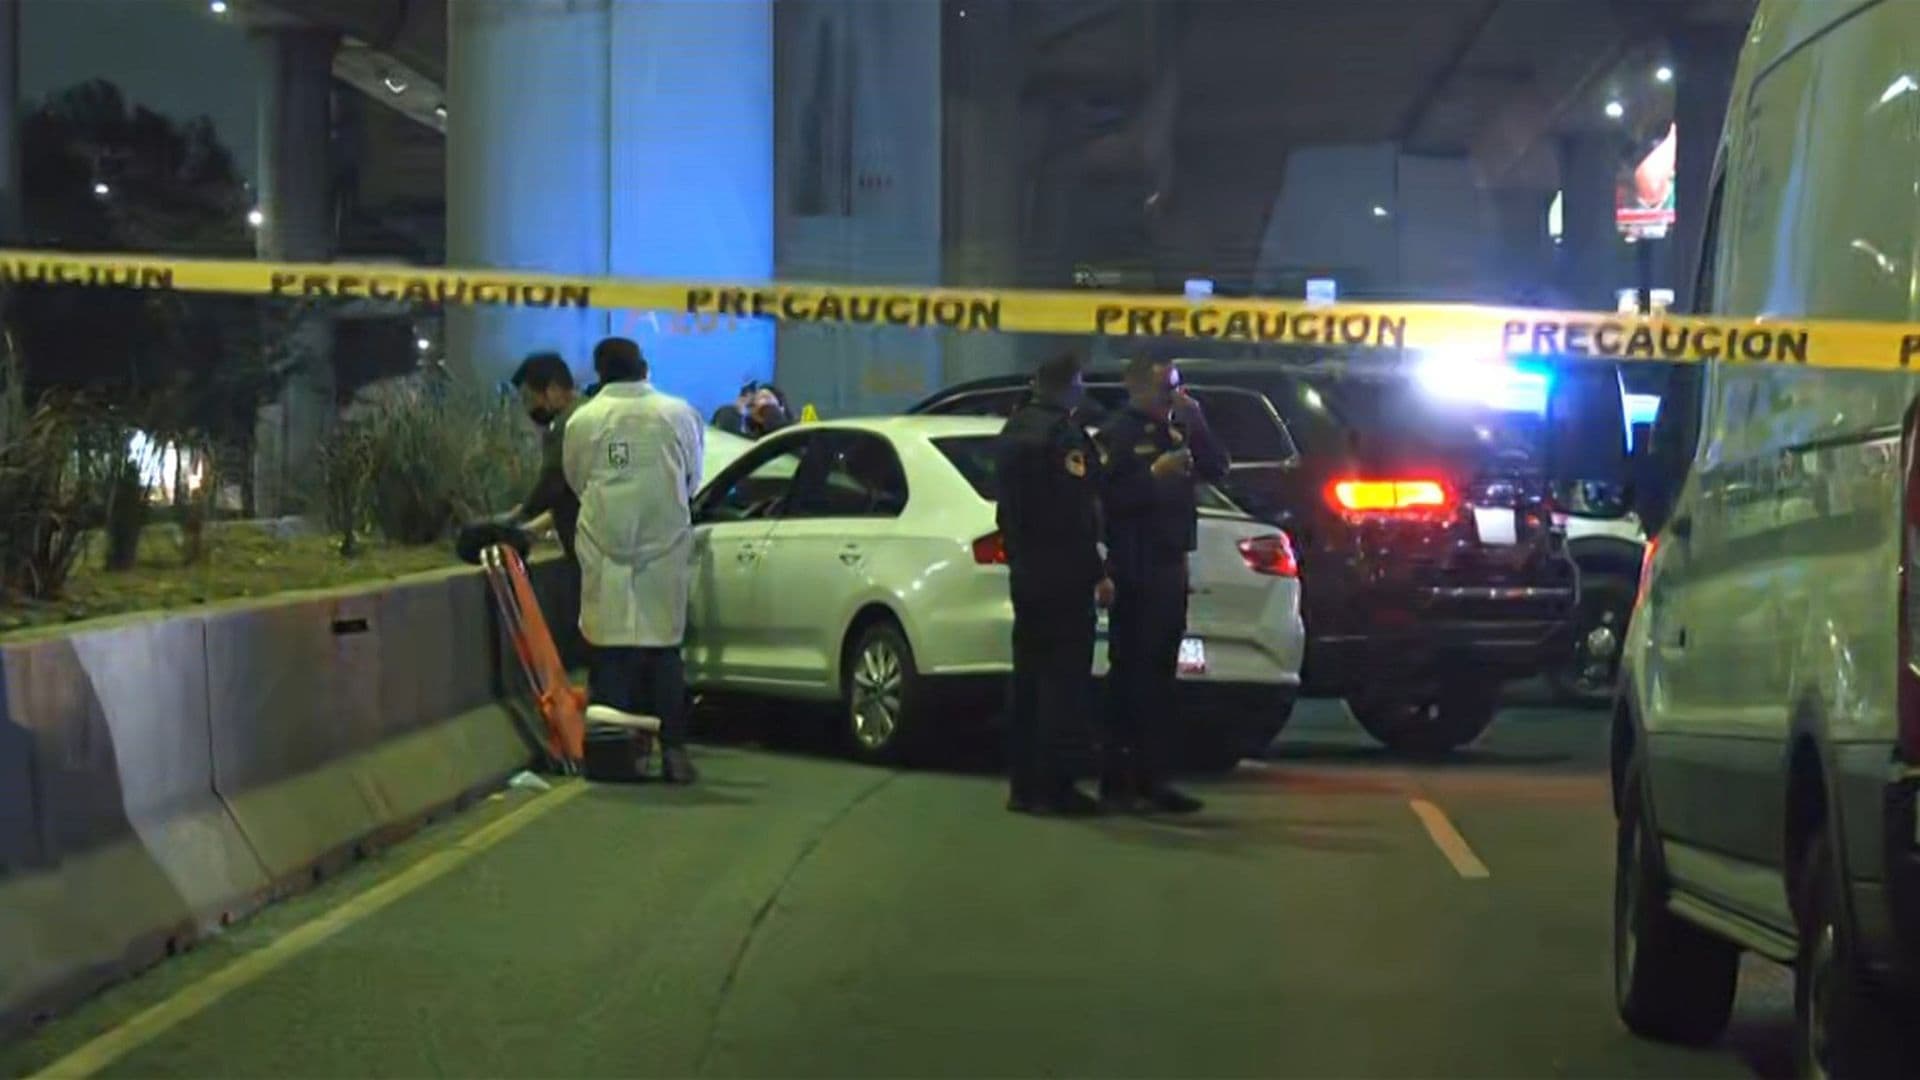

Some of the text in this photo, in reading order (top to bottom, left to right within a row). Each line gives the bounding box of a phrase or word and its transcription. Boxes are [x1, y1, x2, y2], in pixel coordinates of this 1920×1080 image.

[270, 272, 593, 308] PRECAUCION
[686, 288, 1000, 330] PRECAUCION
[1095, 306, 1407, 347] PRECAUCION
[1502, 320, 1809, 362] PRECAUCION
